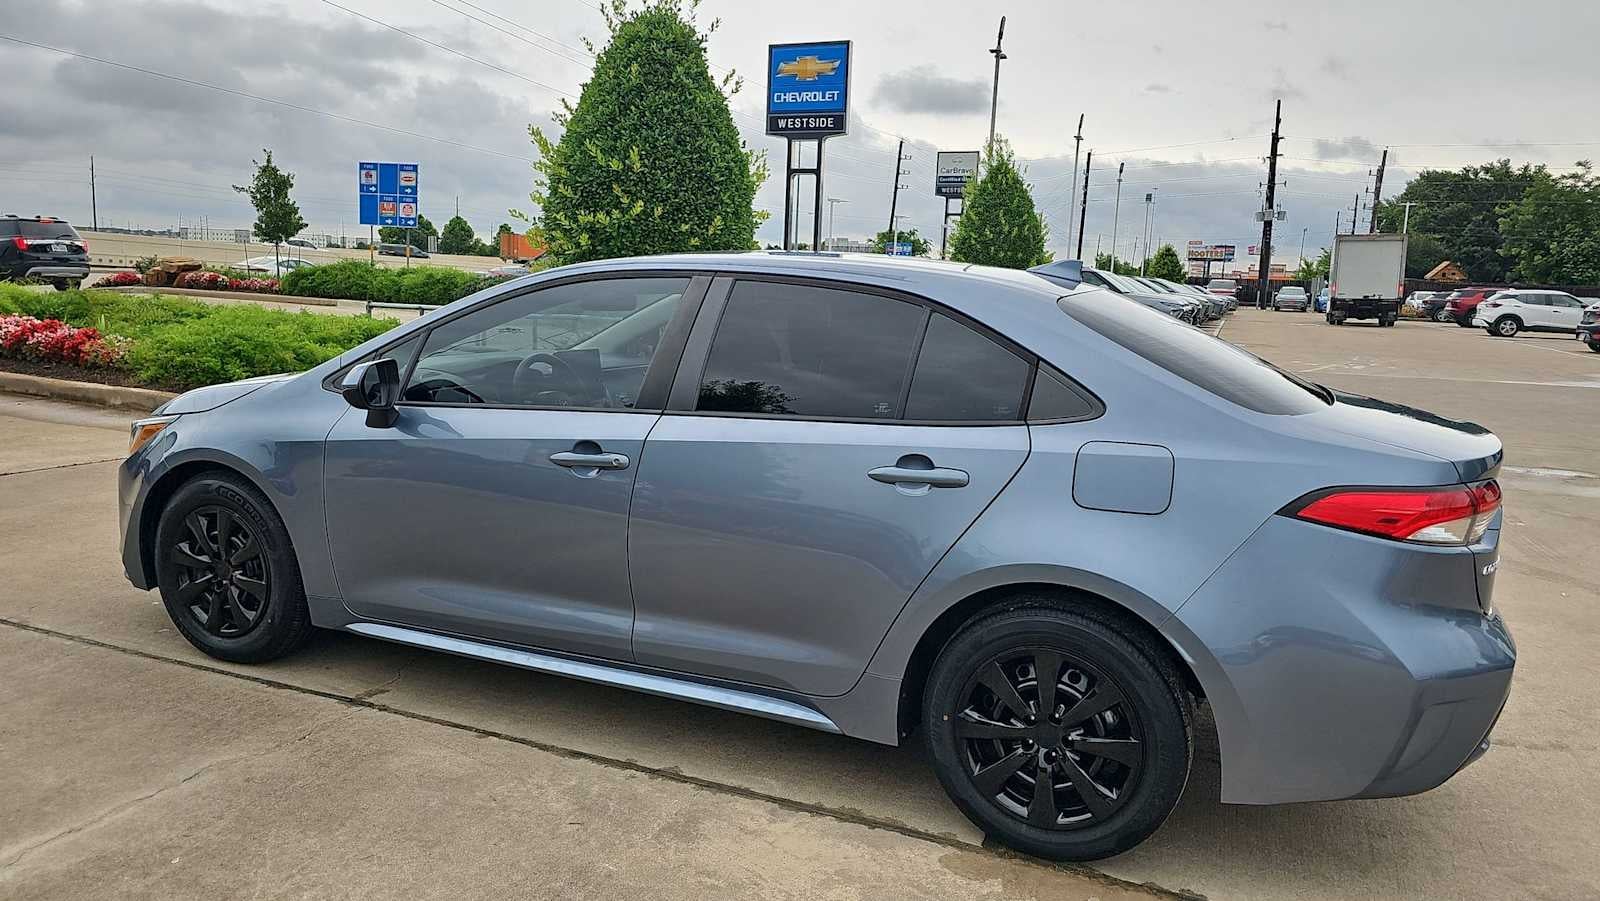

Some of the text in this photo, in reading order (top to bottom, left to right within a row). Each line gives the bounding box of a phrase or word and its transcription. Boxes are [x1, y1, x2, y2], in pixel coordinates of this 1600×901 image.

[774, 91, 839, 102] CHEVROLET
[778, 118, 834, 128] WESTSIDE
[1188, 250, 1224, 258] HOOTERS
